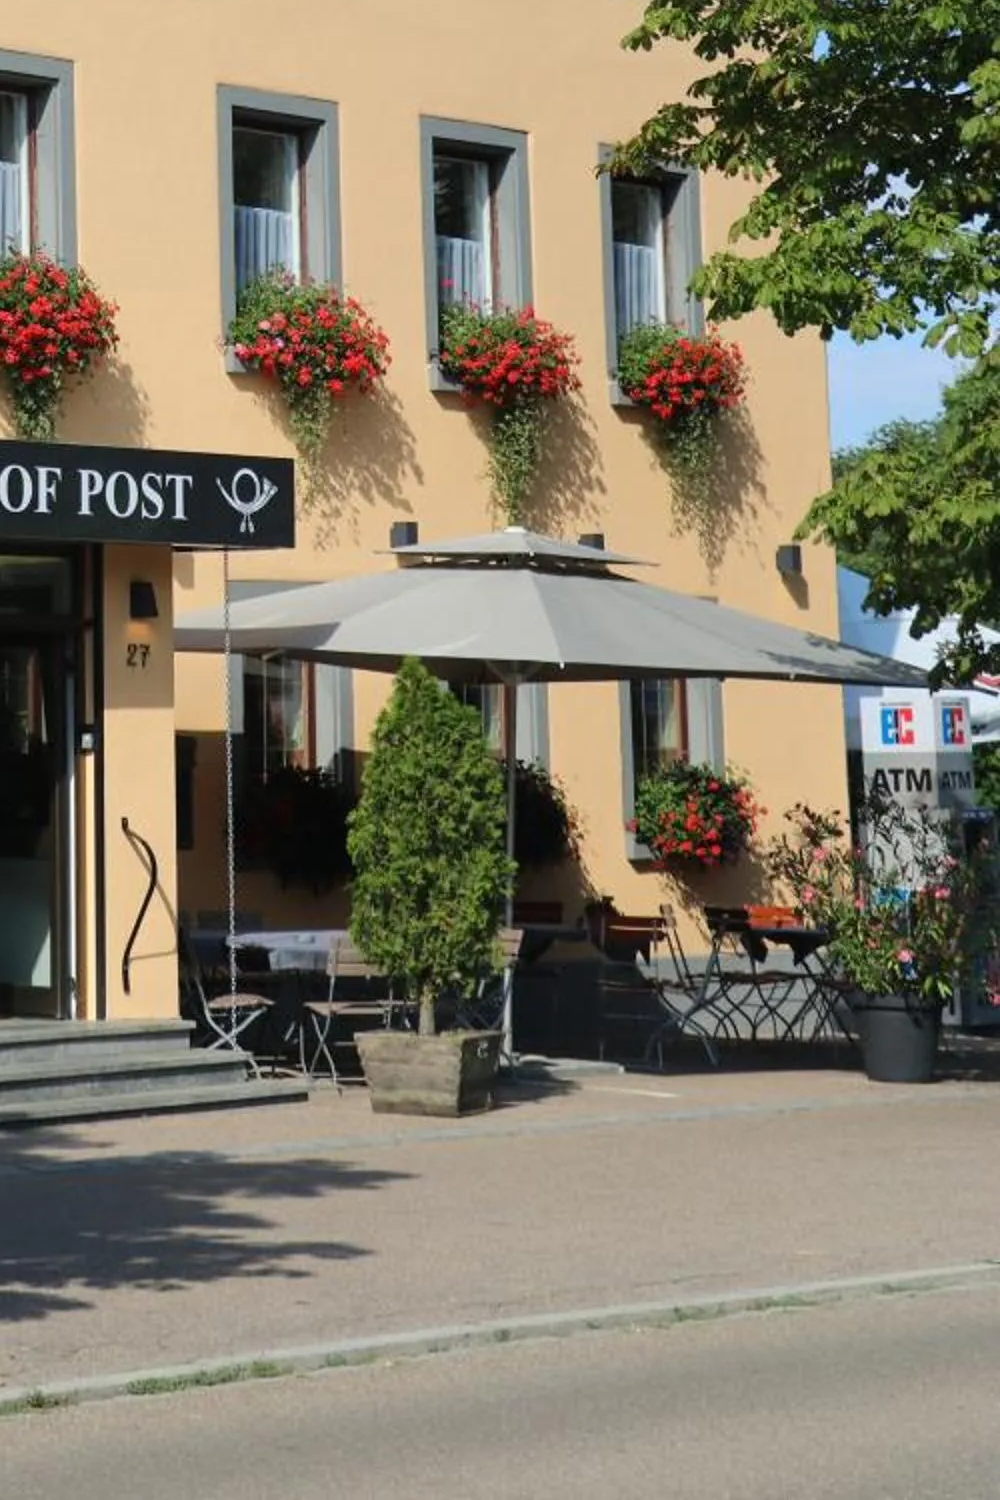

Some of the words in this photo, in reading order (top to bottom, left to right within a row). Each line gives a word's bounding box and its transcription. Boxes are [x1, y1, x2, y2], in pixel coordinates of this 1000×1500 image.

[77, 469, 193, 520] POST
[126, 643, 150, 669] 27
[870, 768, 933, 797] ATM
[940, 770, 971, 790] ATM
